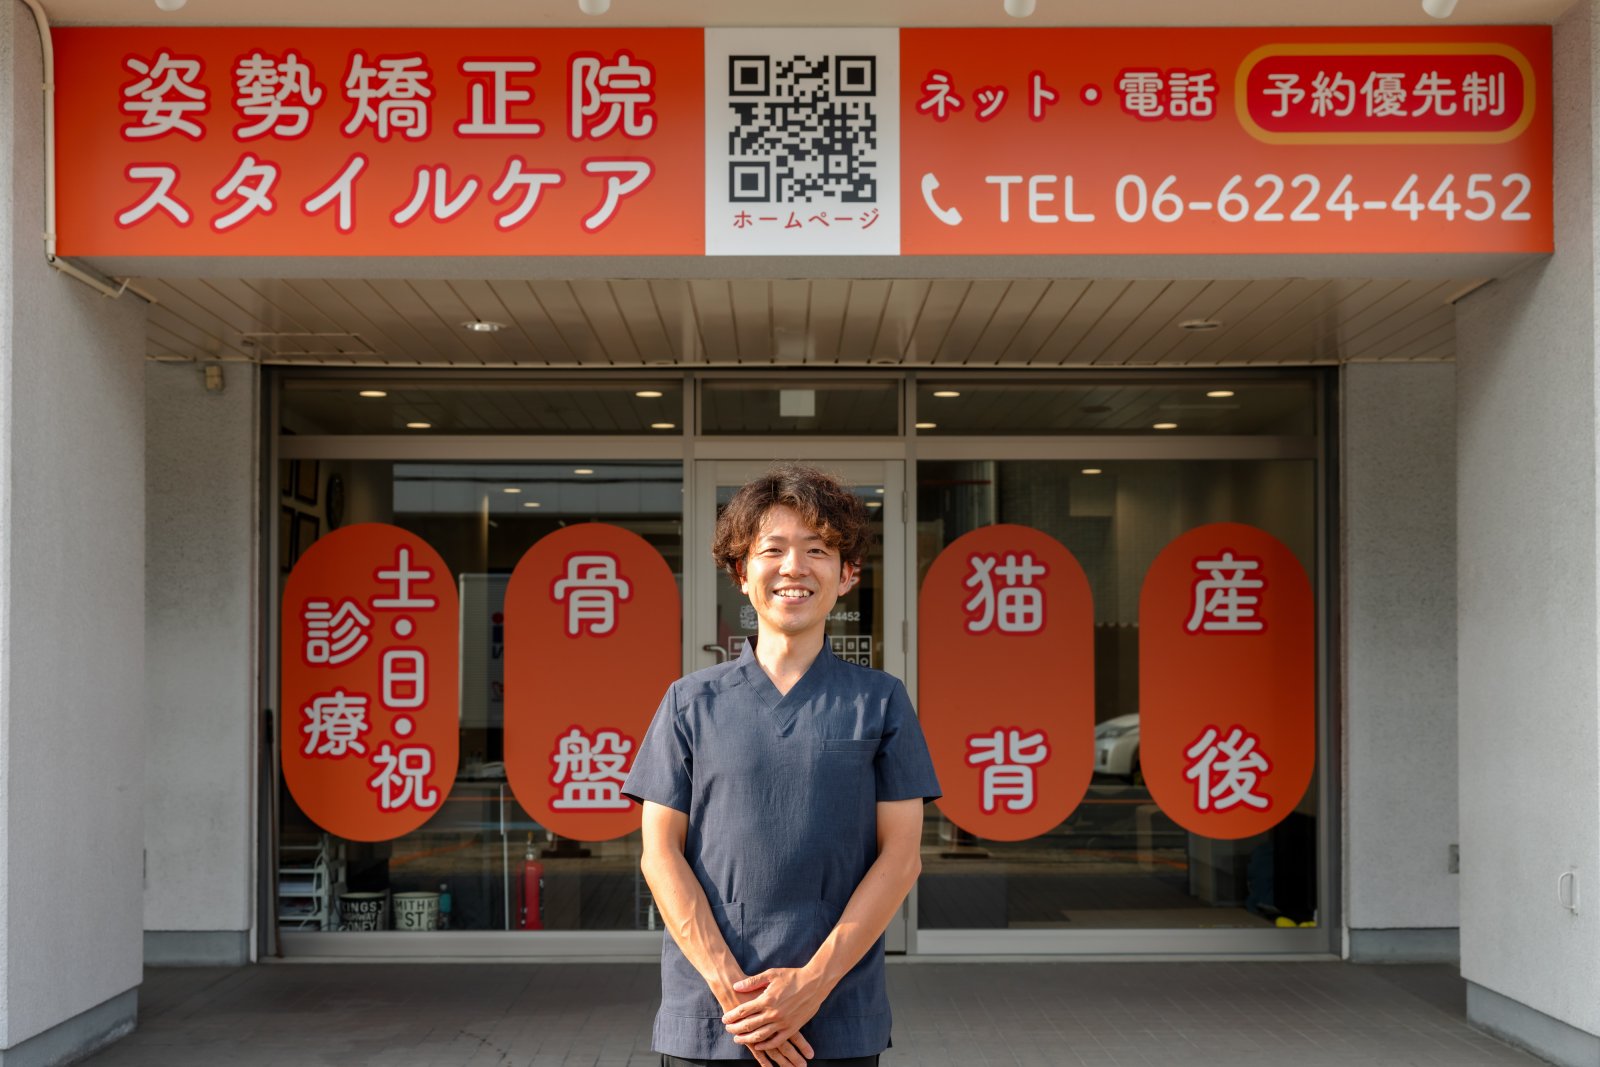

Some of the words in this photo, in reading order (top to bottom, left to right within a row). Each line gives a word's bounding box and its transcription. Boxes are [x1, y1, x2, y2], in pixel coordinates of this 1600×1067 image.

[123, 52, 654, 138] 姿勢矯正院
[921, 72, 1216, 117] ネット・電話
[1263, 71, 1506, 117] 予約優先制
[118, 156, 652, 231] スタイルケア
[733, 207, 879, 230] ホームページ
[985, 174, 1096, 223] TEL
[1115, 173, 1532, 223] 06-6224-4452
[303, 600, 371, 756] 診療
[371, 548, 438, 809] 土・日・祝
[551, 555, 633, 809] 骨盤
[966, 554, 1048, 811] 猫背
[1186, 552, 1269, 810] 産後
[405, 911, 424, 927] ST
